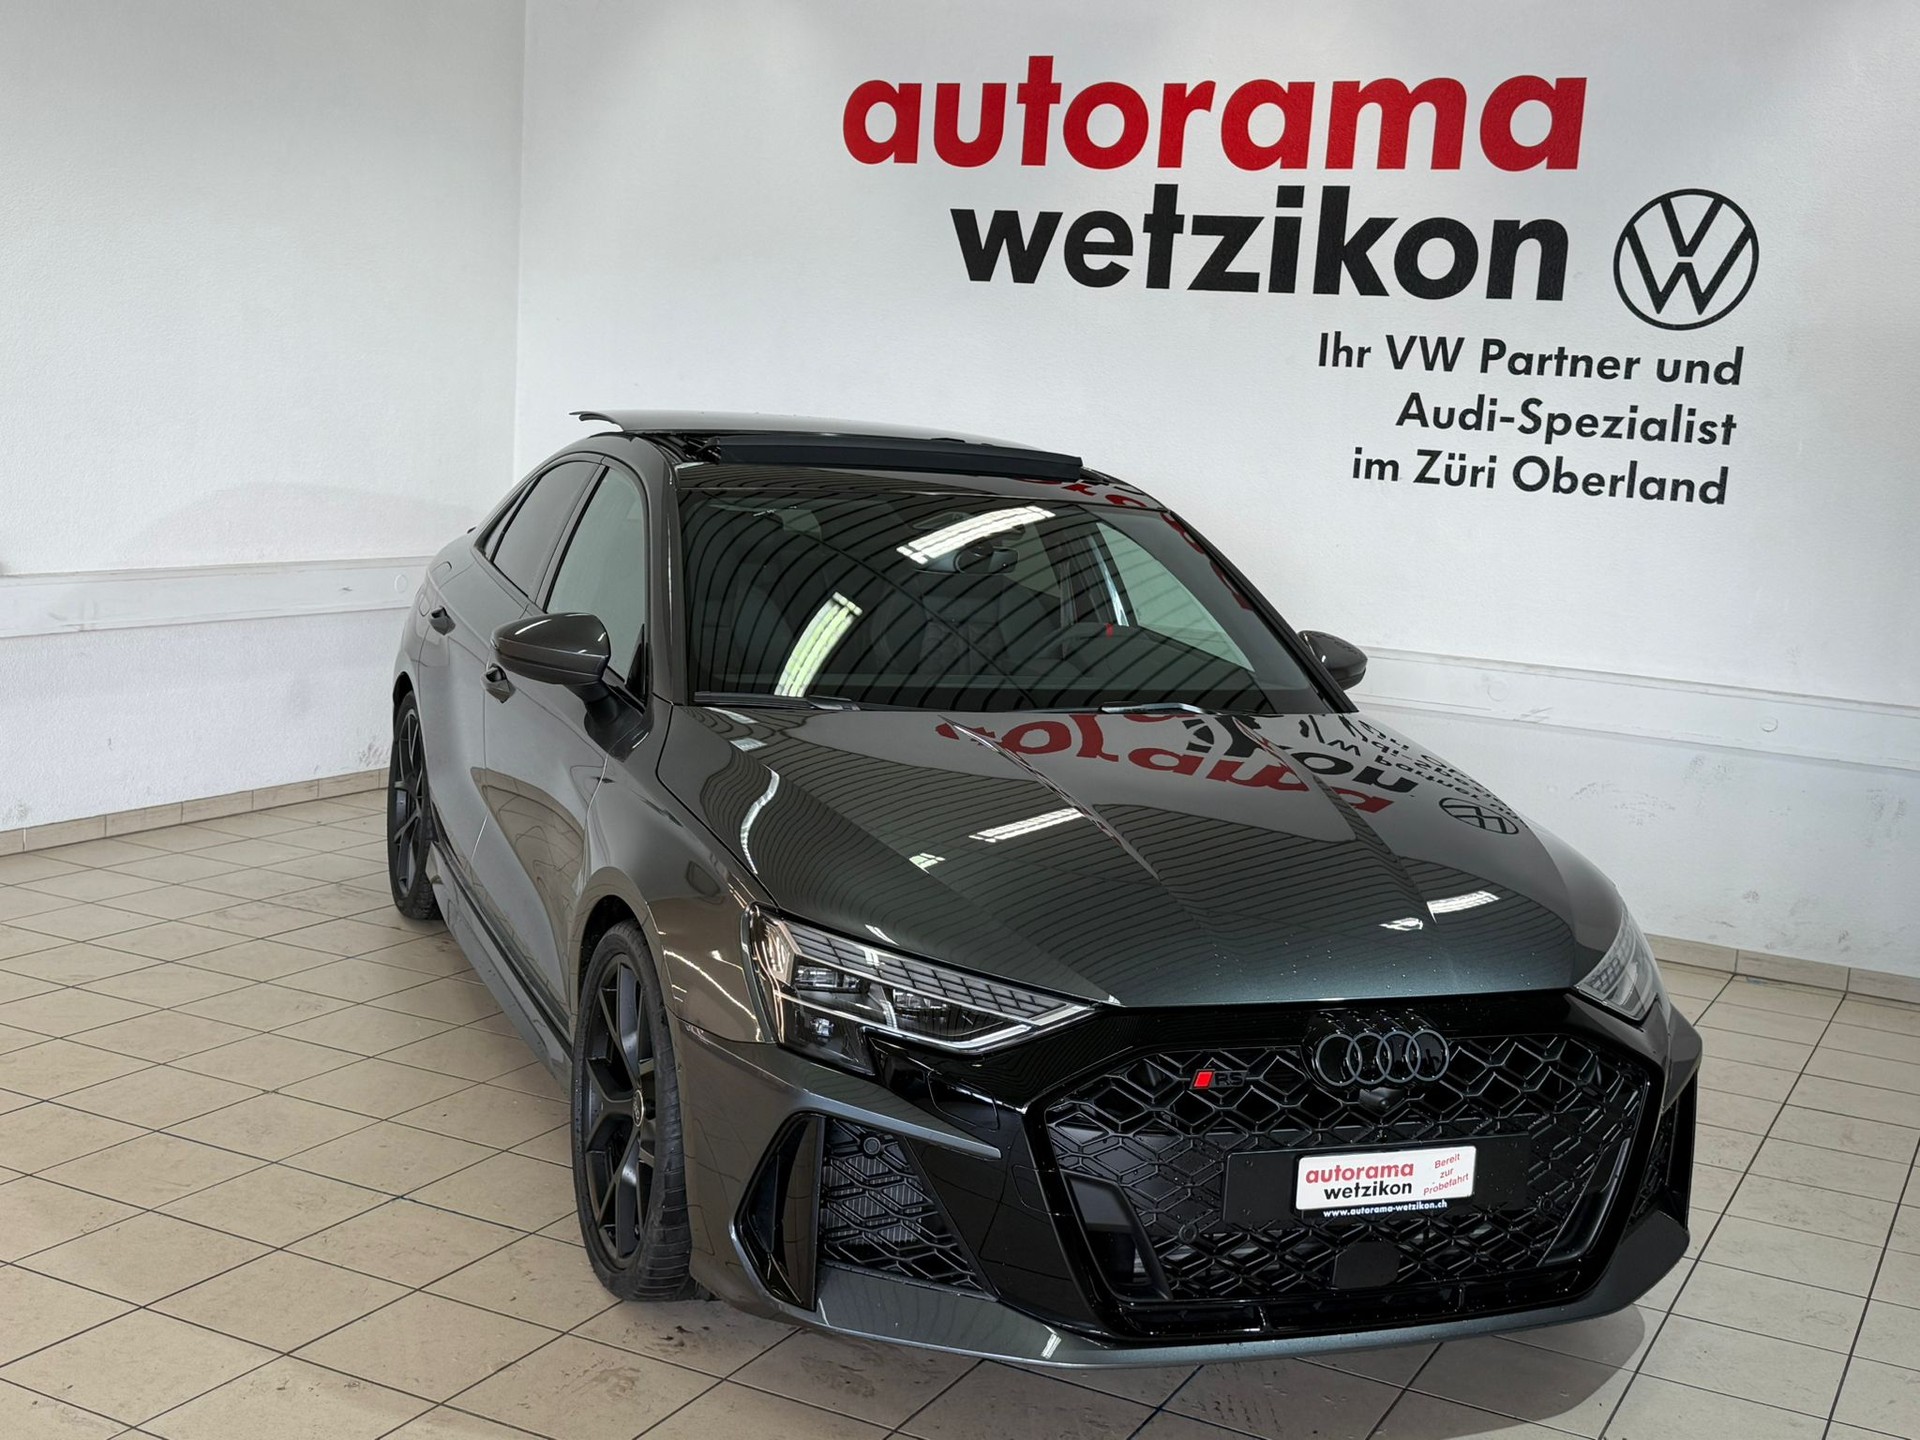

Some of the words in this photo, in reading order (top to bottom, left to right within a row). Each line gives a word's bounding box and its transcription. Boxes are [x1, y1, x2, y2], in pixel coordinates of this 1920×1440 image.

[844, 57, 1586, 172] autorama
[950, 184, 1568, 301] wetzikon
[1319, 331, 1371, 367] Ihr
[1386, 335, 1464, 371] VW
[1481, 339, 1640, 379] Partner
[1657, 347, 1743, 385] und
[1396, 393, 1736, 445] Audi-Spezialist
[1353, 447, 1399, 481] im
[1414, 449, 1496, 488] Züri
[1513, 456, 1728, 504] Oberland
[1434, 1153, 1460, 1169] Bereit
[1305, 1163, 1414, 1184] autorama
[1423, 1173, 1469, 1196] Probefahrt
[1440, 1168, 1454, 1178] zur
[1324, 1181, 1412, 1200] wetzikon
[1323, 1199, 1447, 1218] www.autorama-wetzikon.ch
